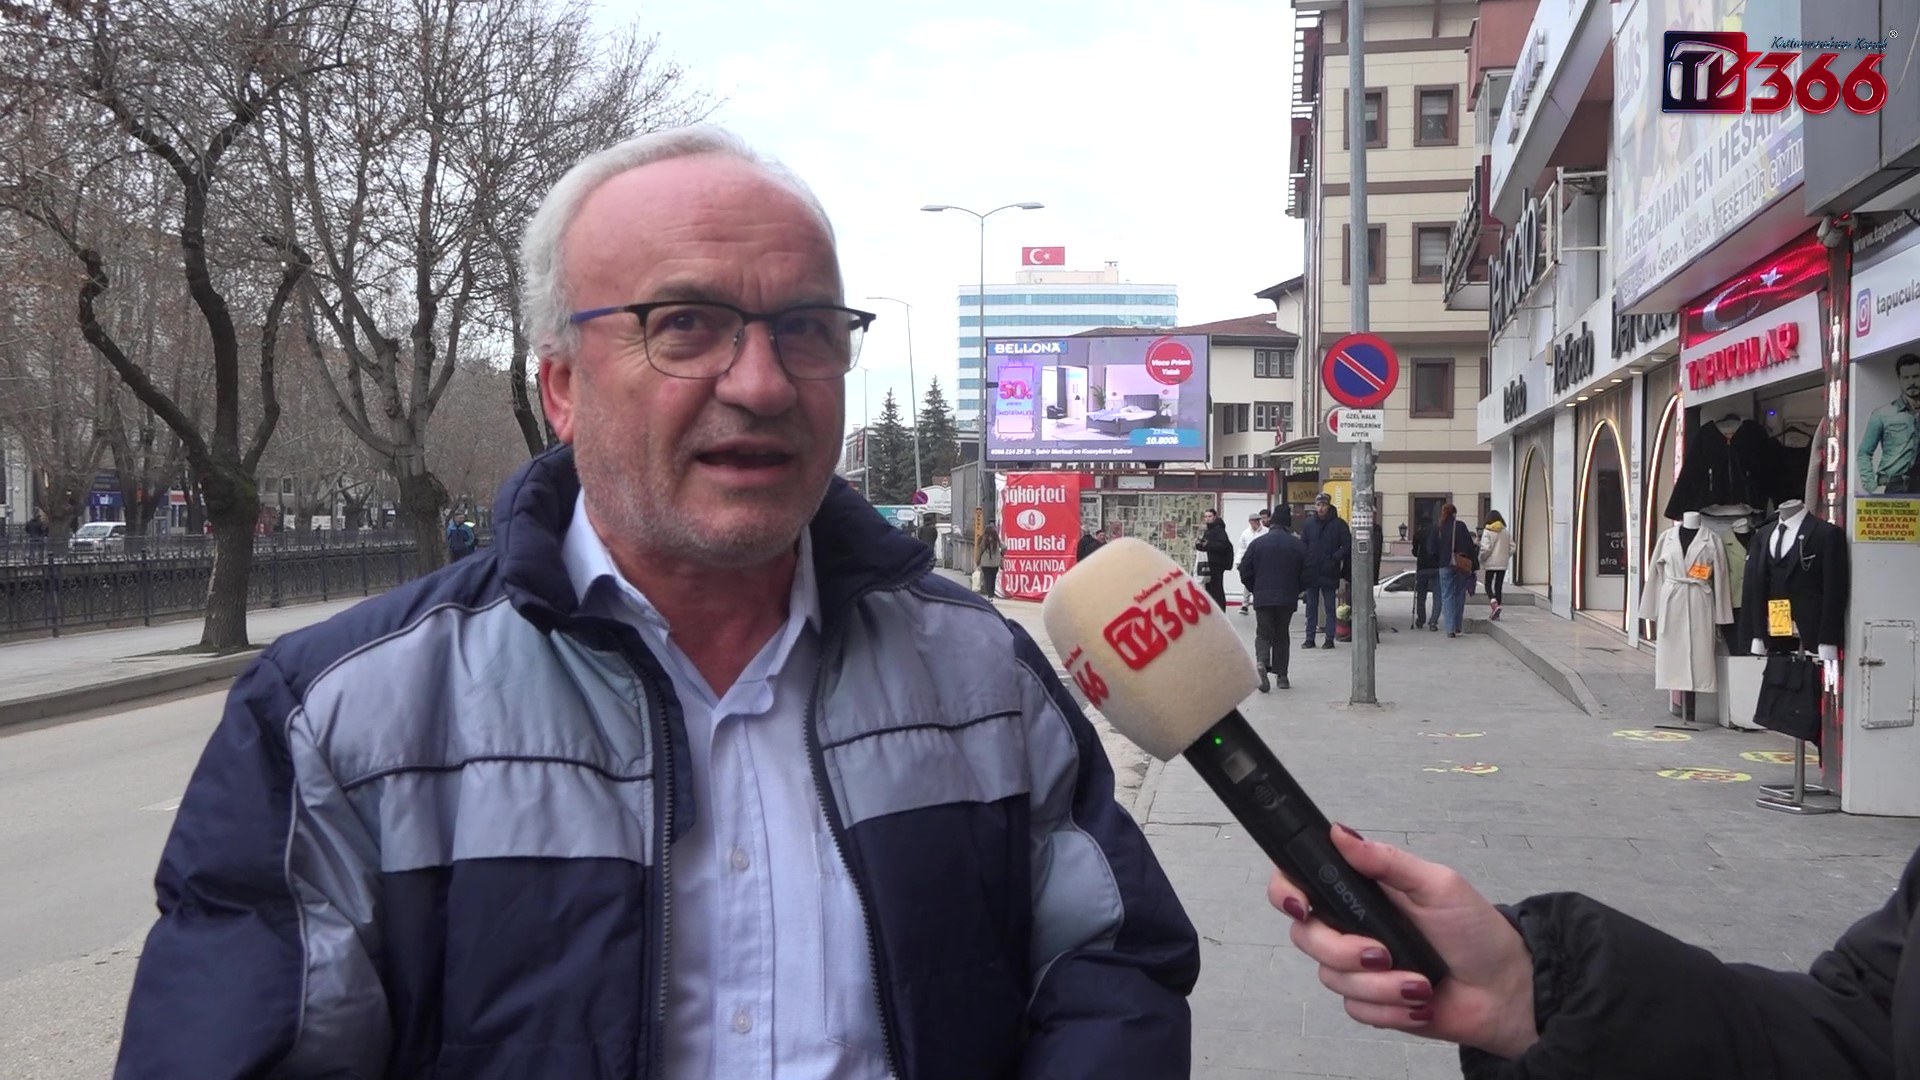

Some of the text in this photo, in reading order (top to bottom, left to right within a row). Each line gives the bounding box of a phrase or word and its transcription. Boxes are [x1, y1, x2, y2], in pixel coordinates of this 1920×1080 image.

[1695, 147, 1714, 198] EN
[995, 342, 1061, 354] BELLONA
[1685, 321, 1800, 391] TAPUCULAR
[1005, 485, 1066, 507] iğköfteci
[1005, 533, 1066, 552] mer Usta
[1860, 529, 1916, 537] ARANIYOR
[1020, 559, 1066, 573] YAKINDA
[1334, 880, 1366, 921] BOYA
